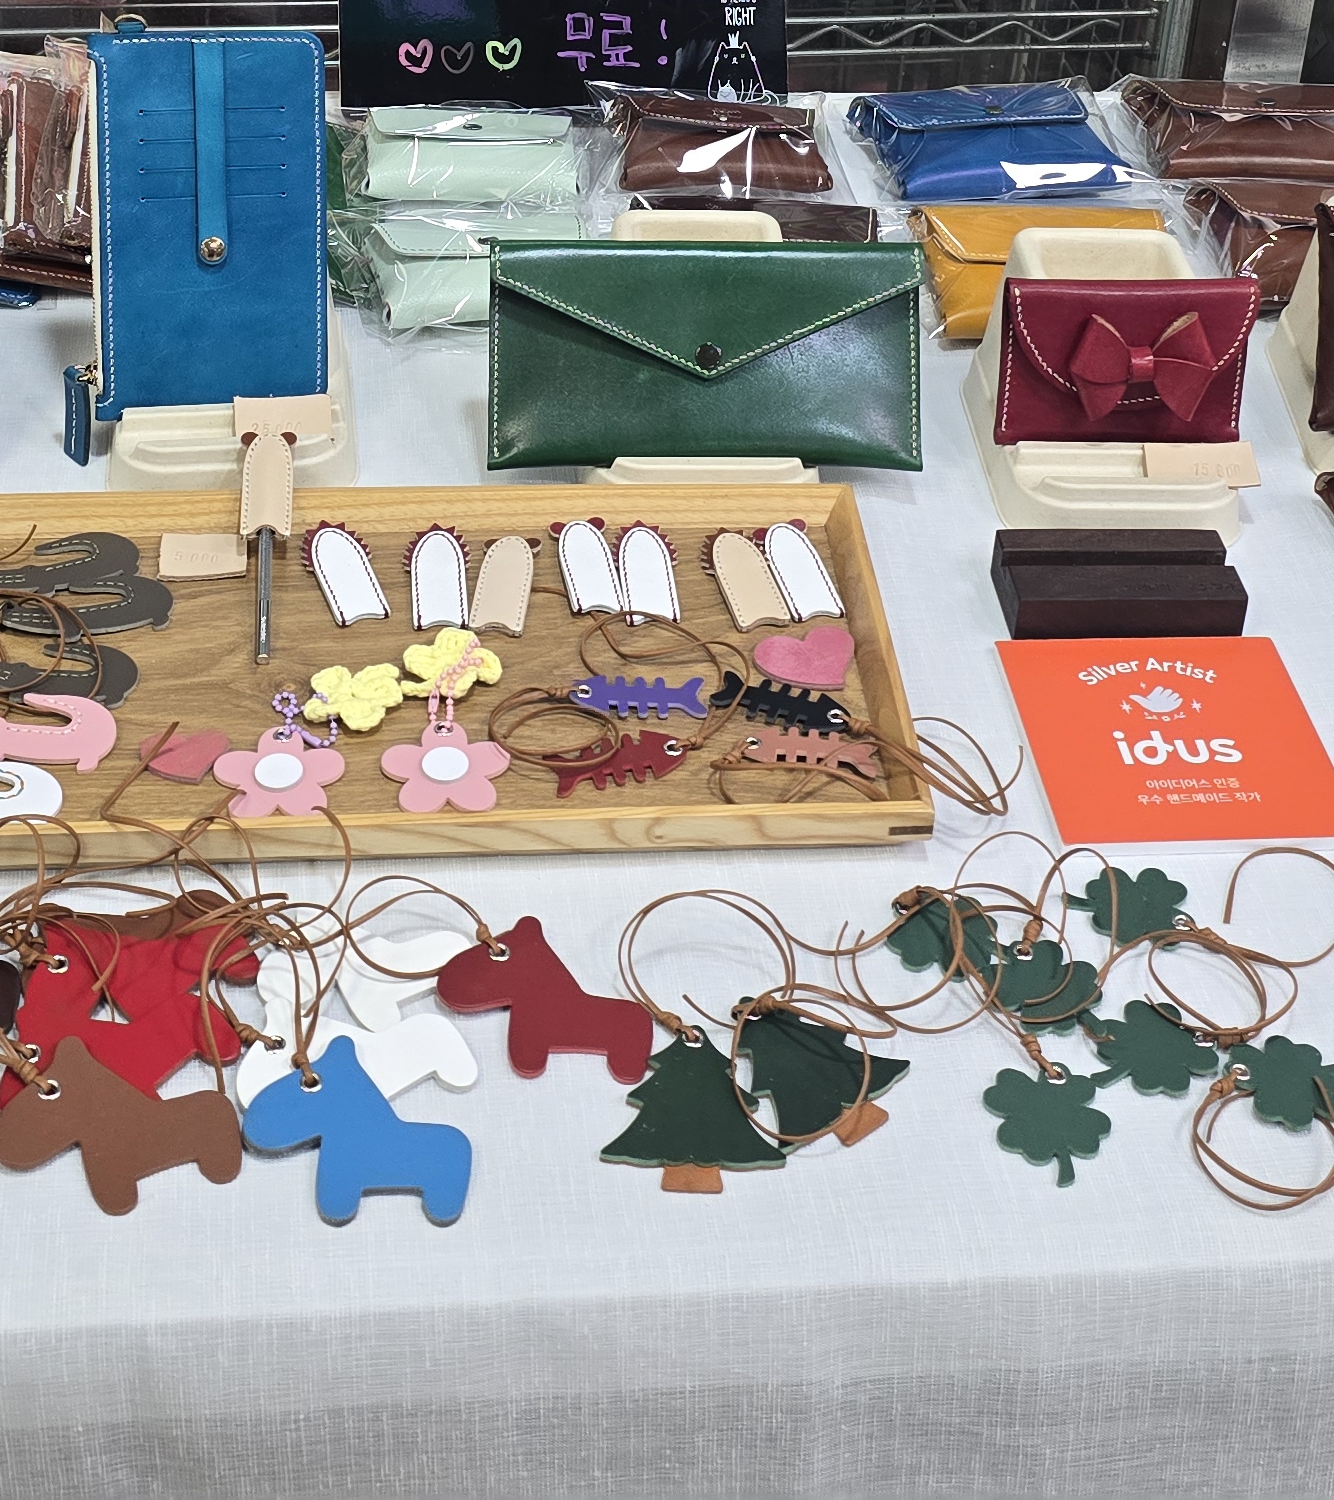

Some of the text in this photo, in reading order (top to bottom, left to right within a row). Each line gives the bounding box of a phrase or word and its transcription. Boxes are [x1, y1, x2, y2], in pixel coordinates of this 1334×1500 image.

[725, 8, 755, 26] RIGHT
[1078, 658, 1217, 685] Silver Artist
[1112, 730, 1243, 765] idus
[1146, 778, 1240, 789] 아이디어스 인증
[1138, 794, 1163, 805] 우수
[1235, 792, 1261, 802] 작가
